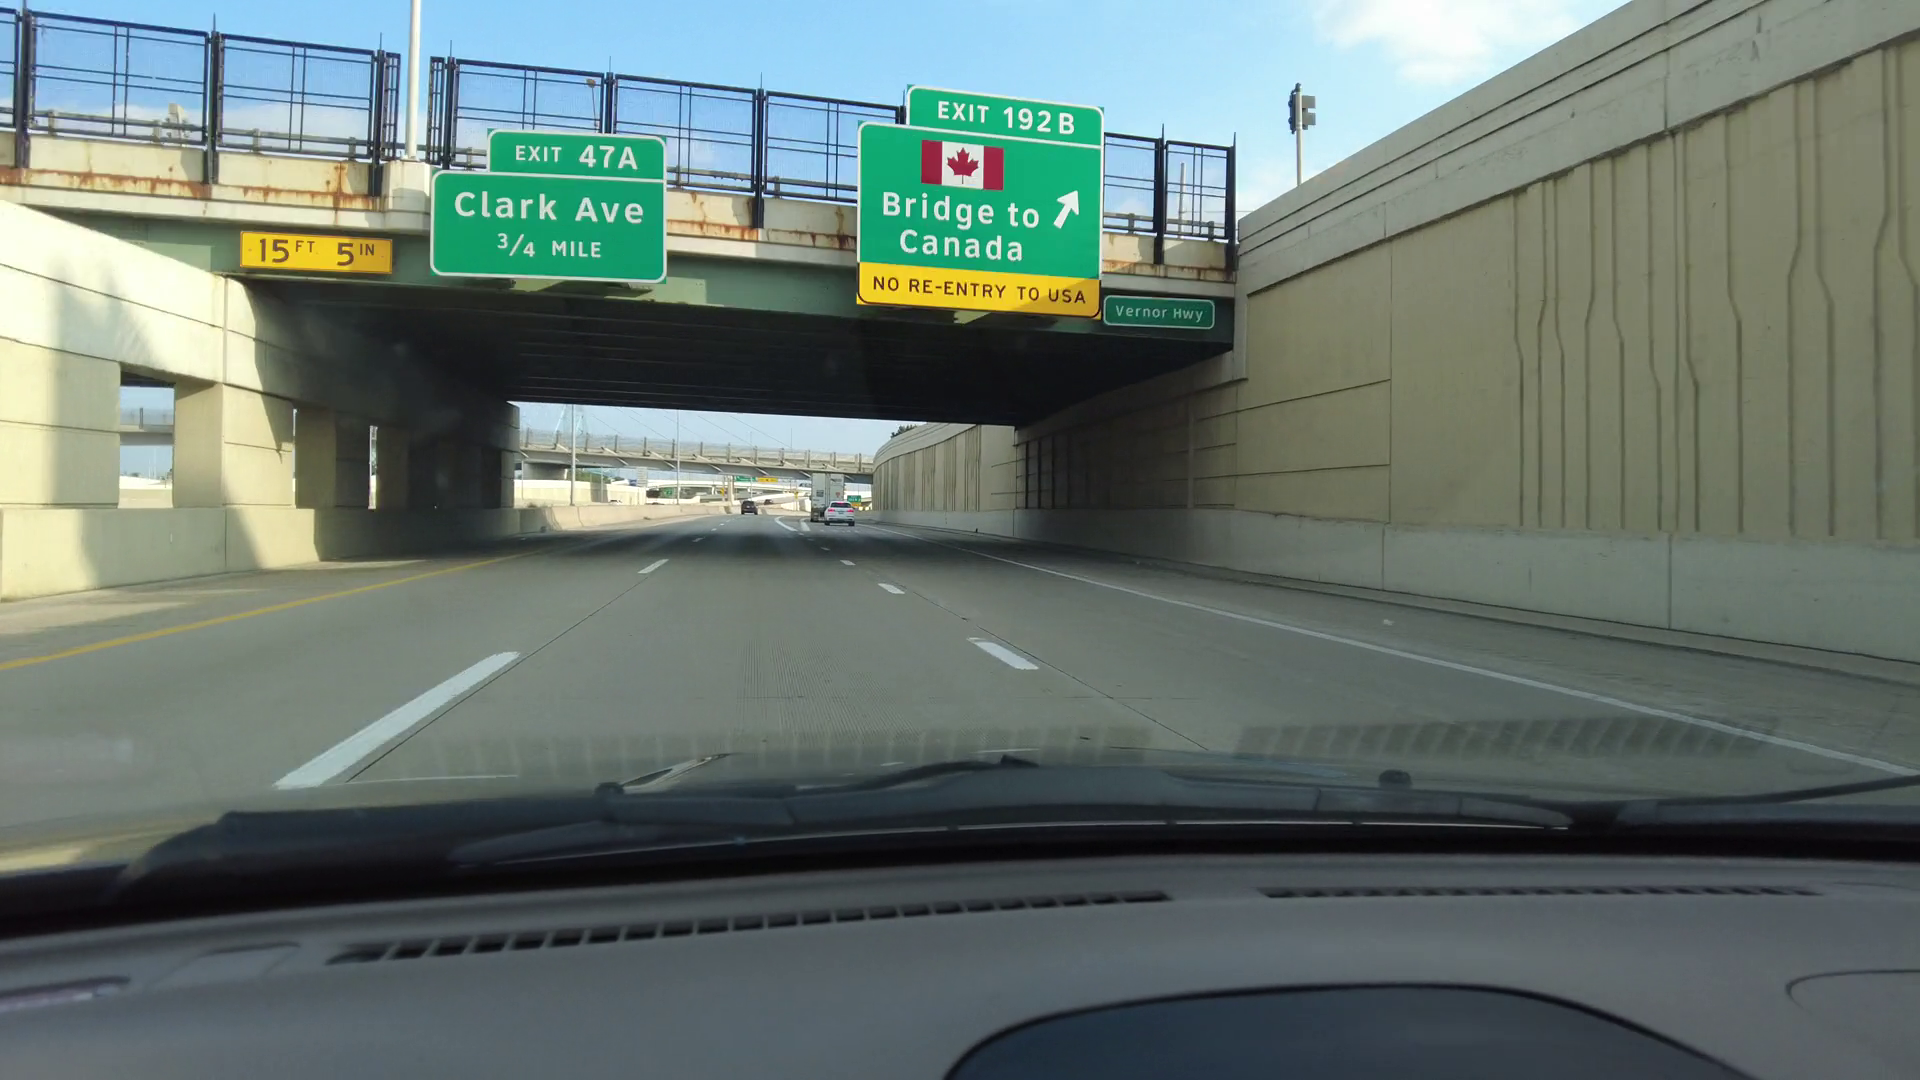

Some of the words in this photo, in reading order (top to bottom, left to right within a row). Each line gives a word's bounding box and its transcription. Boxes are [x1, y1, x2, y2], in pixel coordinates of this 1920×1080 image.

[938, 101, 989, 123] EXIT
[1003, 106, 1075, 135] 192B
[516, 145, 561, 163] EXIT
[579, 145, 638, 170] 47A
[455, 191, 556, 220] Clark
[575, 198, 644, 225] Ave
[883, 192, 994, 230] Bridge
[1008, 203, 1039, 228] to
[262, 235, 292, 264] 15
[296, 239, 317, 253] FT
[337, 243, 355, 267] 5
[359, 243, 376, 256] IN
[552, 240, 601, 259] MILE
[900, 228, 1023, 262] Canada
[873, 275, 900, 292] NO
[909, 278, 1006, 300] RE-ENTRY
[1017, 285, 1040, 302] TO
[1048, 288, 1086, 305] USA
[1115, 305, 1168, 320] Vernor
[1174, 308, 1204, 323] Hwy
